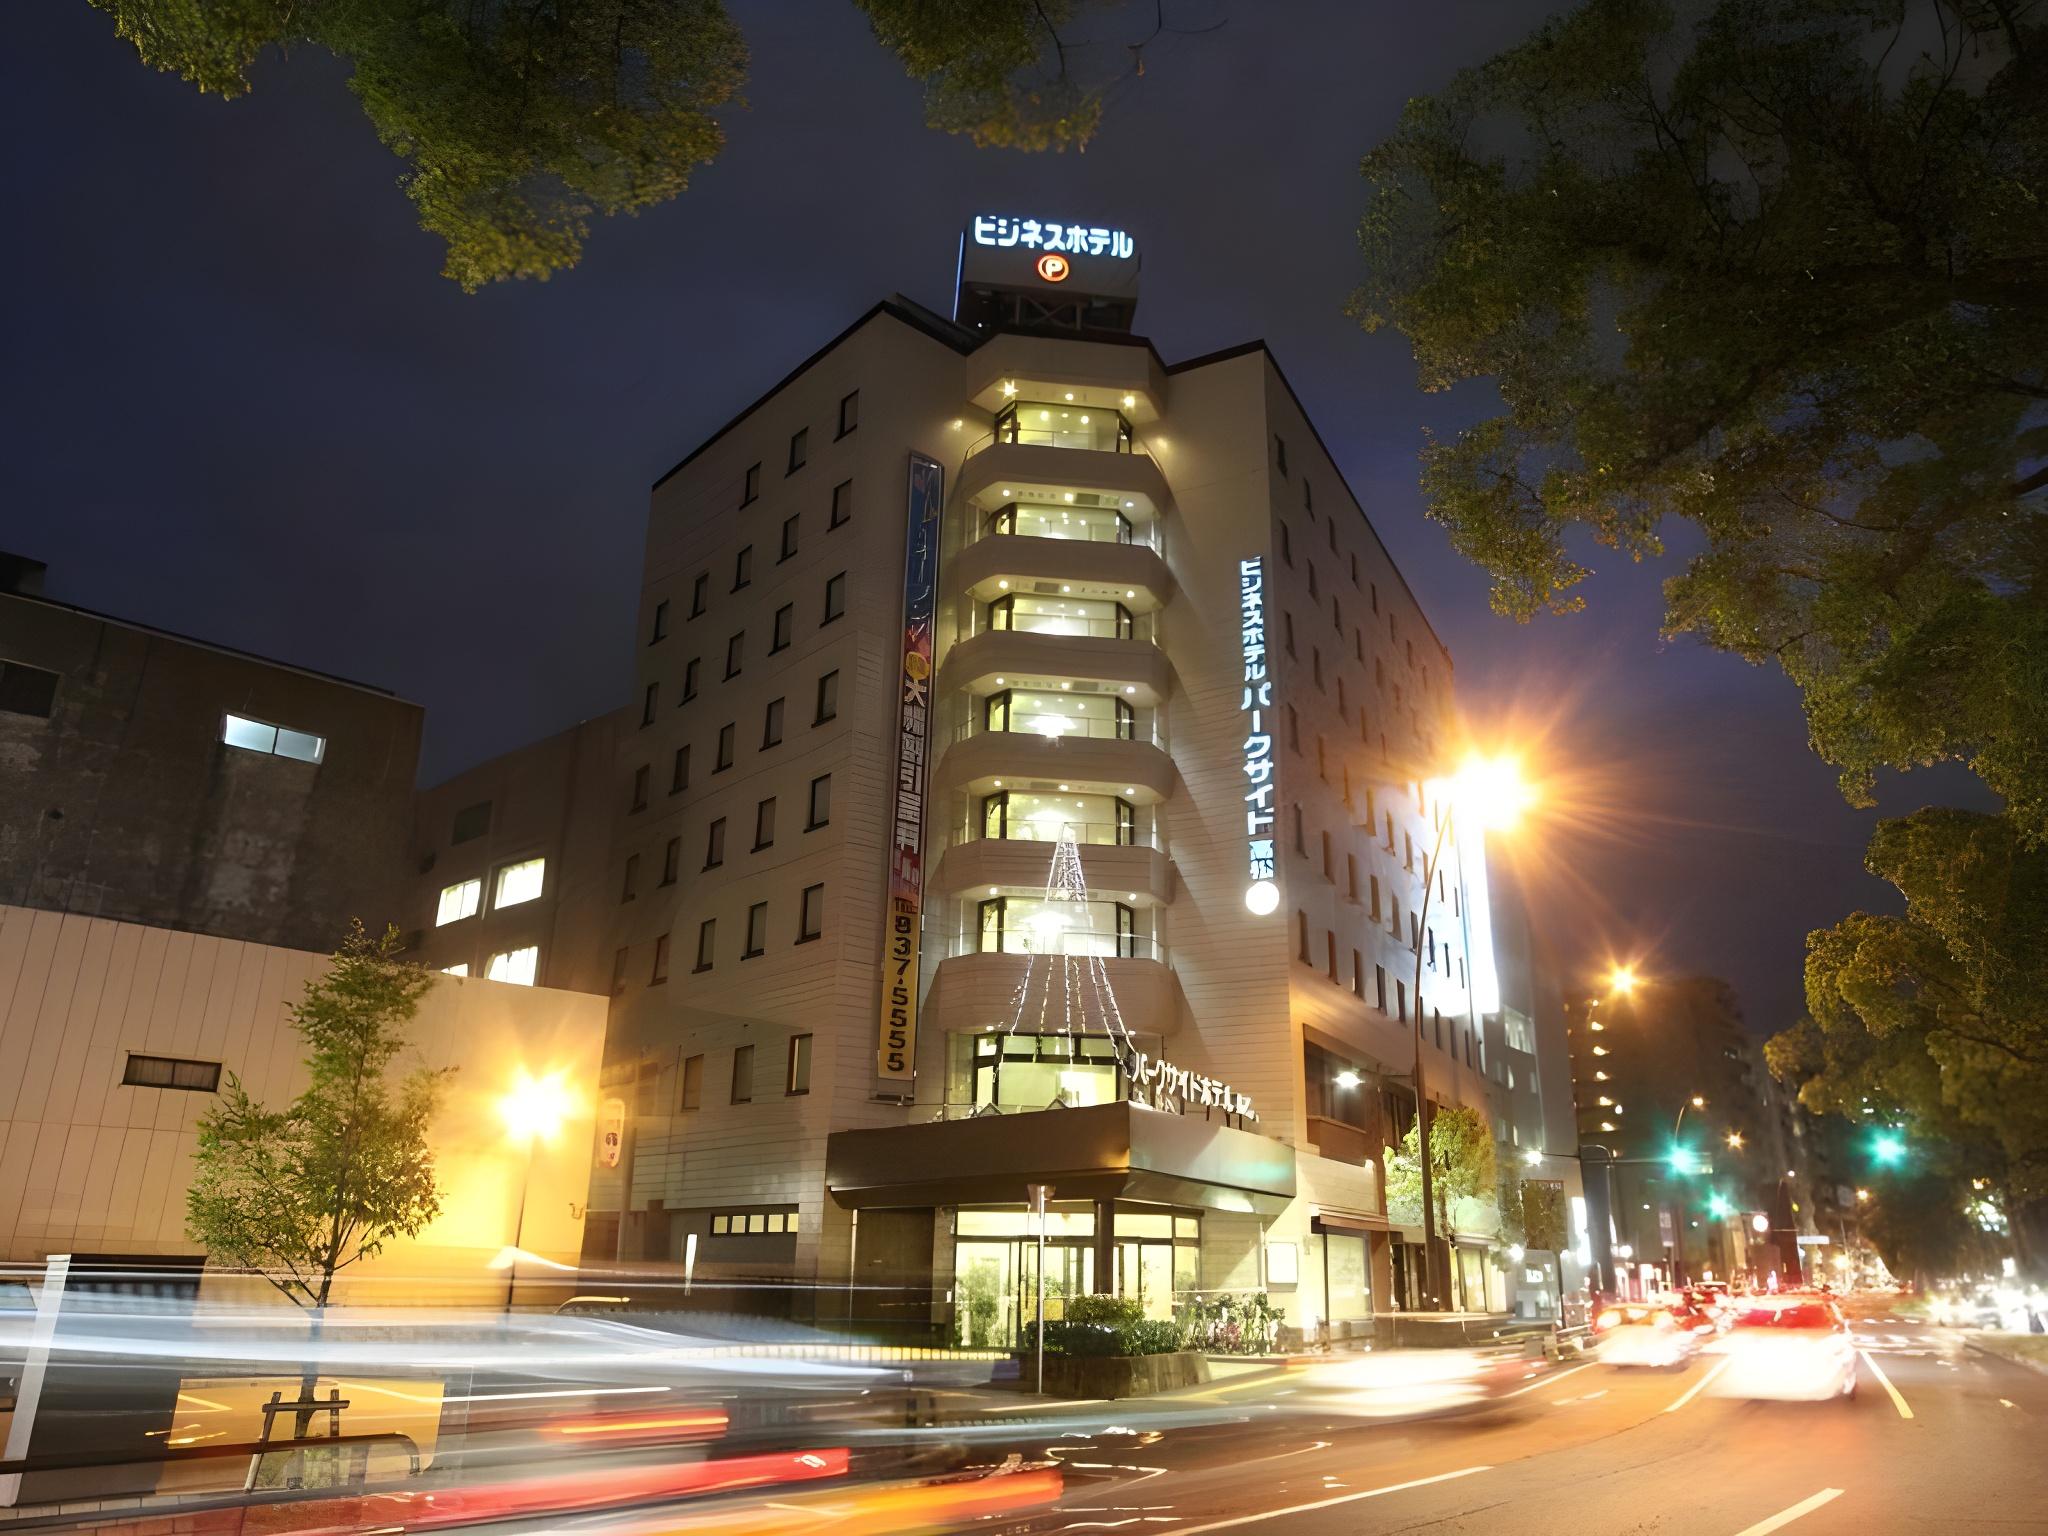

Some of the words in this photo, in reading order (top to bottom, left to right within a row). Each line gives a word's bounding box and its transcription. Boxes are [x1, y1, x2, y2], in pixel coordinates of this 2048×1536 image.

[975, 215, 1134, 258] ビジネスホテル
